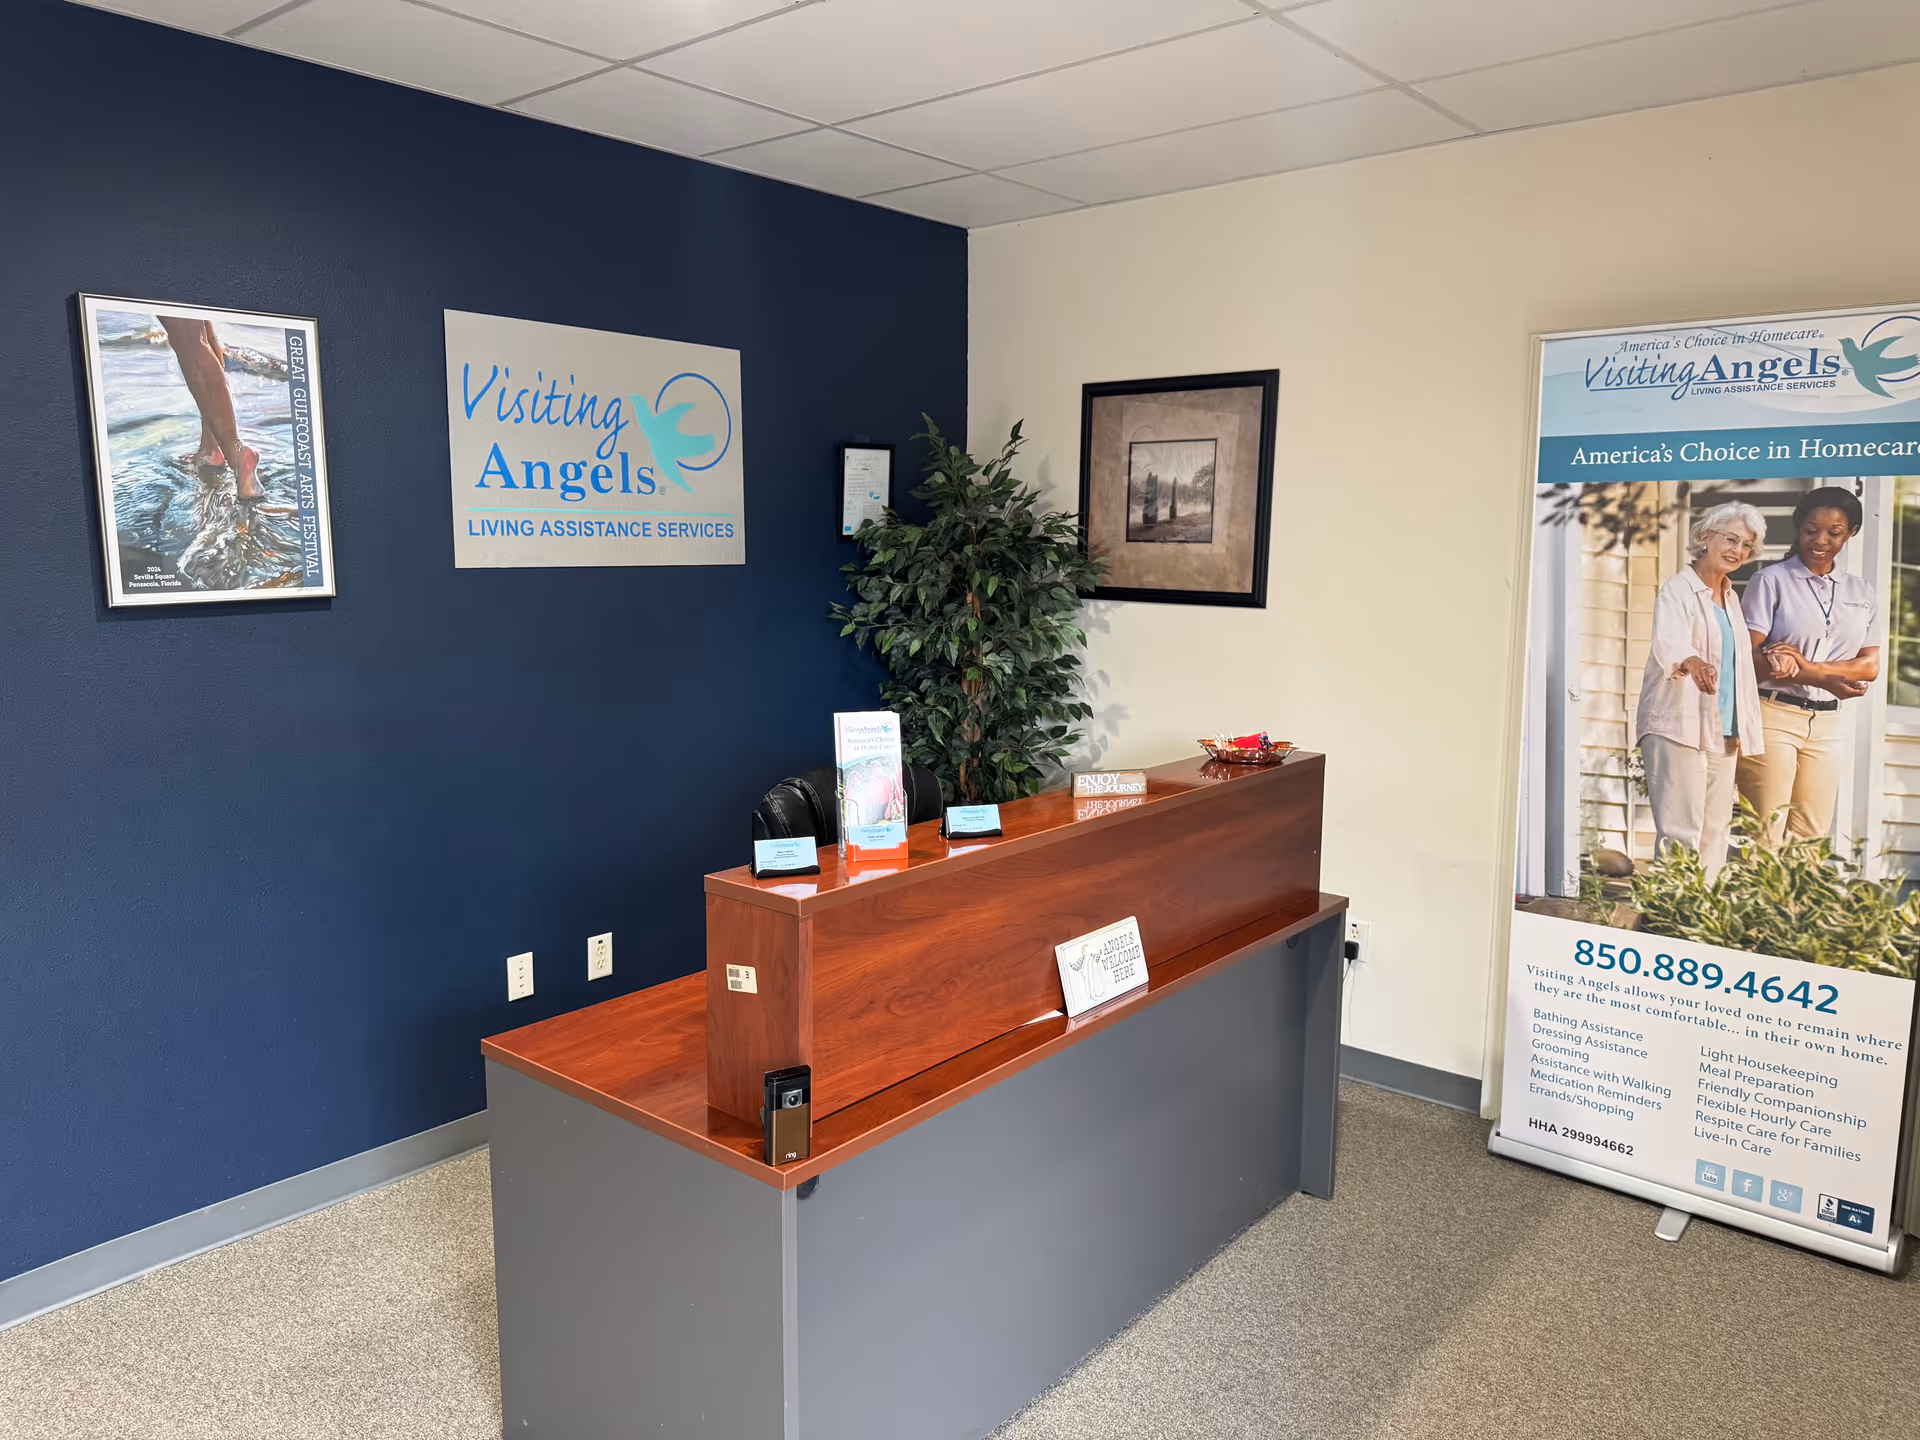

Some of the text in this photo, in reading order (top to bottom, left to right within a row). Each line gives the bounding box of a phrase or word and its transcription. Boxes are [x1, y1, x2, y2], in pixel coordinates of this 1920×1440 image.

[289, 336, 306, 383] GREAT
[1615, 335, 1681, 355] America's
[1684, 333, 1728, 349] Choice
[1732, 331, 1745, 345] in
[1690, 380, 1836, 396] LIVING ASSISTANCE SERVICES
[293, 388, 312, 469] GULFCOAST
[463, 361, 630, 460] Visiting
[1680, 441, 1760, 463] Choice
[1767, 440, 1791, 460] in
[1799, 438, 1920, 459] Homecar
[299, 473, 315, 509] ARTS
[302, 515, 320, 577] FESTIVAL
[468, 519, 734, 538] LIVING ASSISTANCE SERVICES
[1077, 773, 1121, 787] ENJOY
[1085, 783, 1145, 793] THE JOURNEY
[1101, 944, 1141, 971] WELCOME
[1103, 931, 1134, 956] ANGELS
[1112, 963, 1136, 984] HERE
[1574, 939, 1839, 1015] 850.889.4642
[1526, 964, 1903, 1051] Visiting Angels allows your loved one to remain where
[1533, 1008, 1644, 1042] Bathing Assistance
[1534, 981, 1560, 998] they
[1563, 990, 1583, 1001] are
[1586, 993, 1606, 1005] the
[1610, 999, 1641, 1012] most
[1745, 1026, 1759, 1038] in
[1764, 1030, 1800, 1047] their
[1804, 1042, 1836, 1055] own
[1841, 1045, 1888, 1066] home.
[1531, 1038, 1590, 1063] Grooming
[1532, 1023, 1648, 1059] Dressing Assistance
[1530, 1054, 1672, 1099] Assistance with Walking
[1699, 1062, 1814, 1099] Meal Preparation
[1700, 1045, 1838, 1089] Light Housekeeping
[1529, 1082, 1634, 1121] Errands/Shopping
[1530, 1067, 1662, 1110] Medication Reminders
[1698, 1078, 1867, 1130] Friendly Companionship
[1696, 1094, 1832, 1137] Flexible Hourly Care
[1528, 1117, 1634, 1156] HHA 299994662
[1694, 1126, 1772, 1156] Live-In Care
[1695, 1110, 1861, 1162] Respite Care for Families
[785, 1151, 797, 1160] ring
[1848, 1215, 1863, 1224] A+
